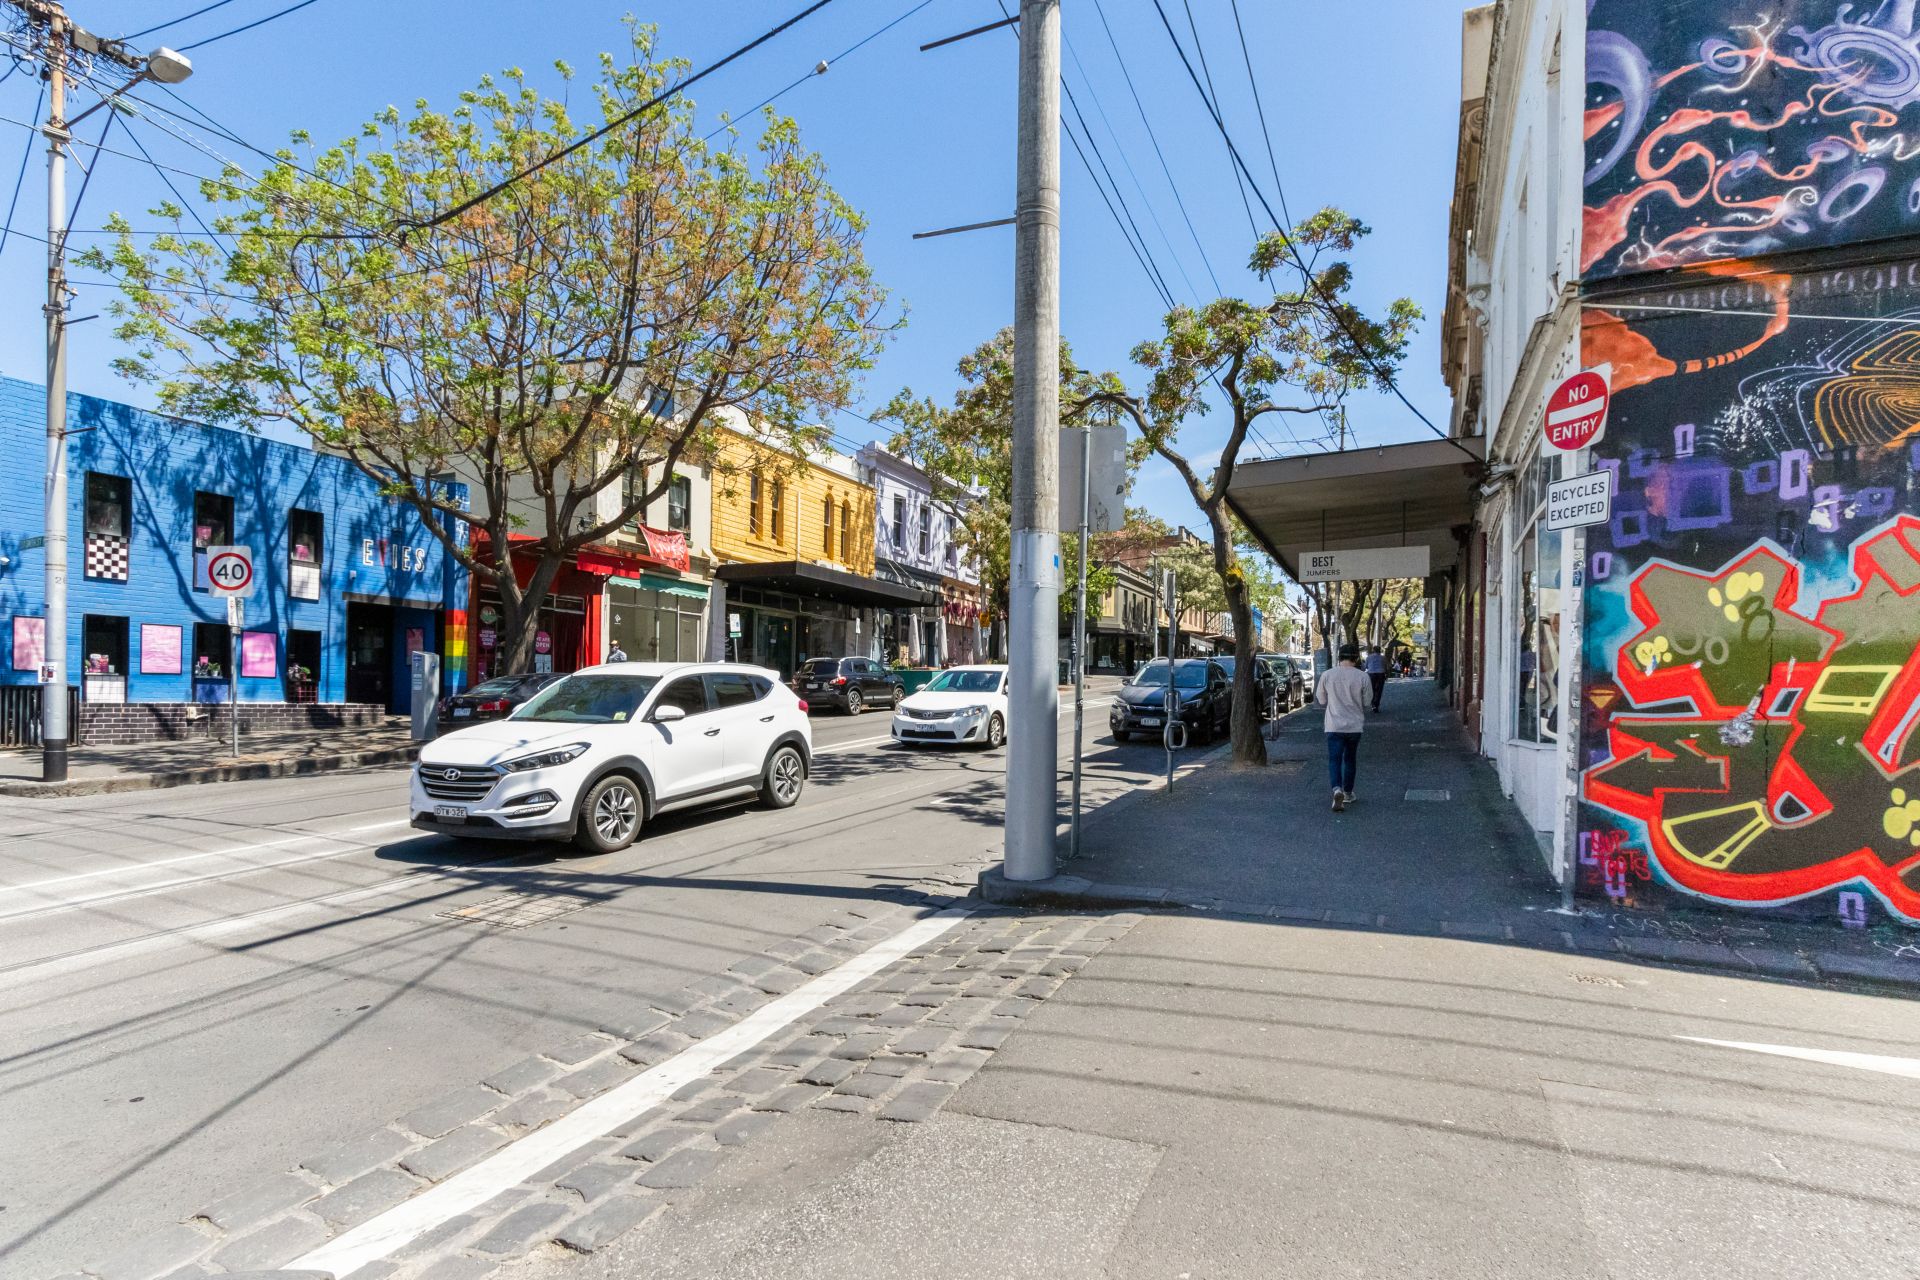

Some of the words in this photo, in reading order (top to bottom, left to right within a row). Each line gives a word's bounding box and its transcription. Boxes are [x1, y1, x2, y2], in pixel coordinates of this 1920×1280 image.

[1568, 385, 1588, 402] NO
[1552, 416, 1598, 442] ENTRY
[1551, 481, 1605, 503] BICYCLES
[1550, 501, 1604, 521] EXCEPTED
[363, 539, 424, 572] EVIES
[1312, 556, 1335, 568] BEST
[216, 563, 244, 580] 40
[1306, 569, 1341, 577] JUMPERS
